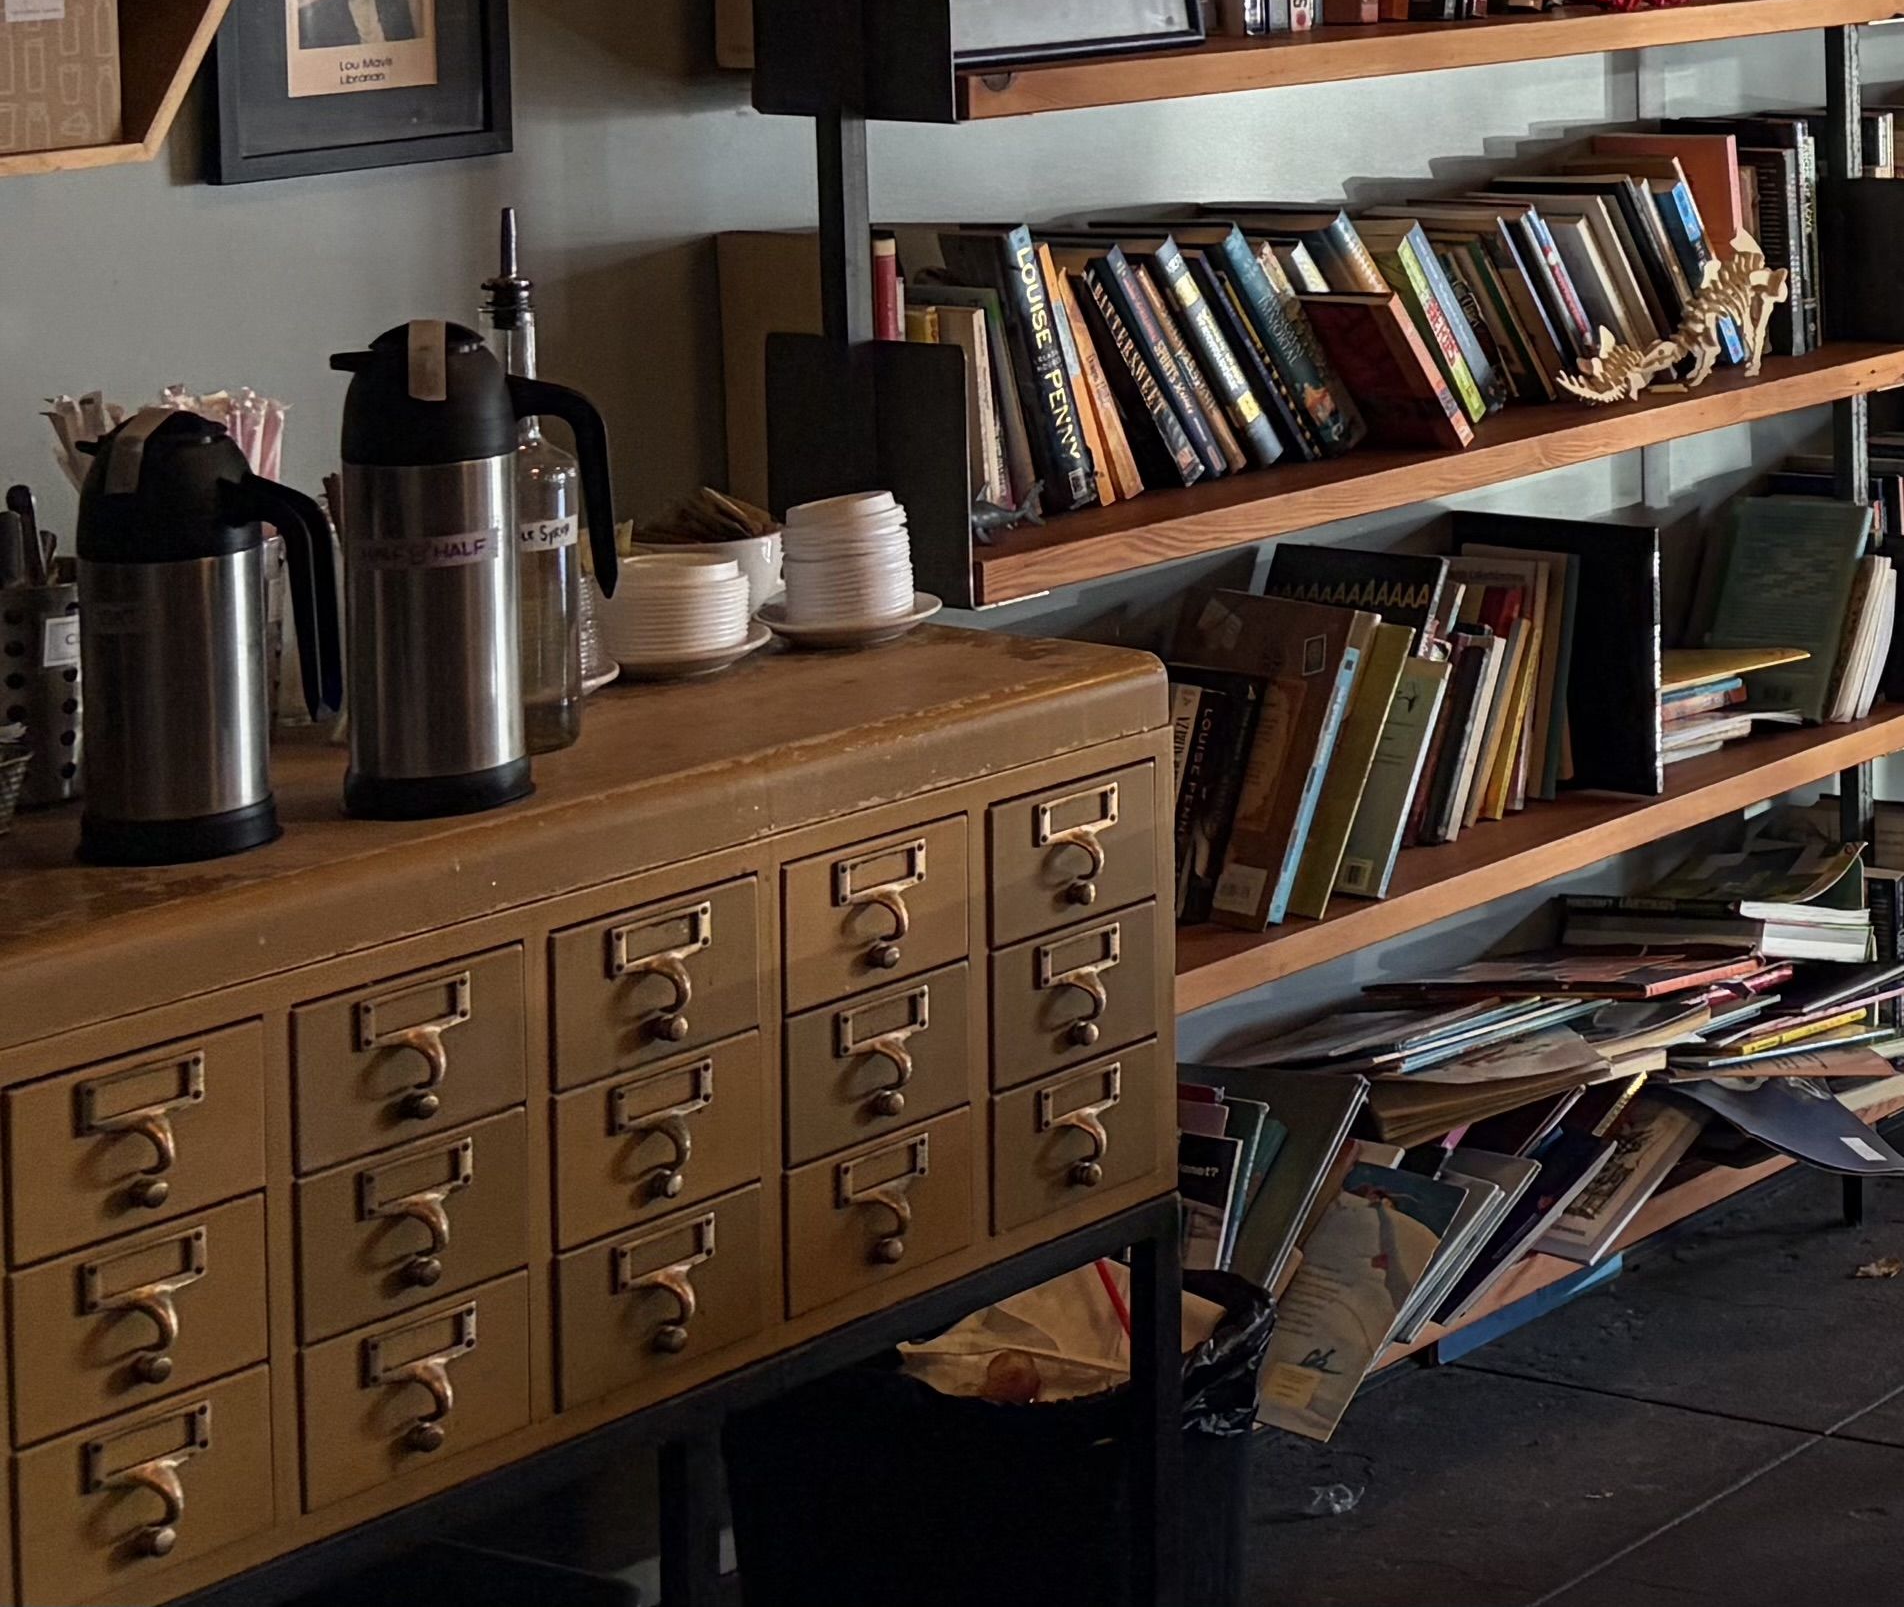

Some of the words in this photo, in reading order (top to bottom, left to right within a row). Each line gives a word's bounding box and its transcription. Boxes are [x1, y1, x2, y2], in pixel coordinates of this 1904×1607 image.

[340, 60, 360, 71] Lou
[340, 71, 386, 85] Librarian
[1017, 247, 1052, 350] LOUISE
[1044, 368, 1080, 459] PENNY
[434, 537, 486, 559] HALF
[1190, 707, 1214, 776] LOUISE
